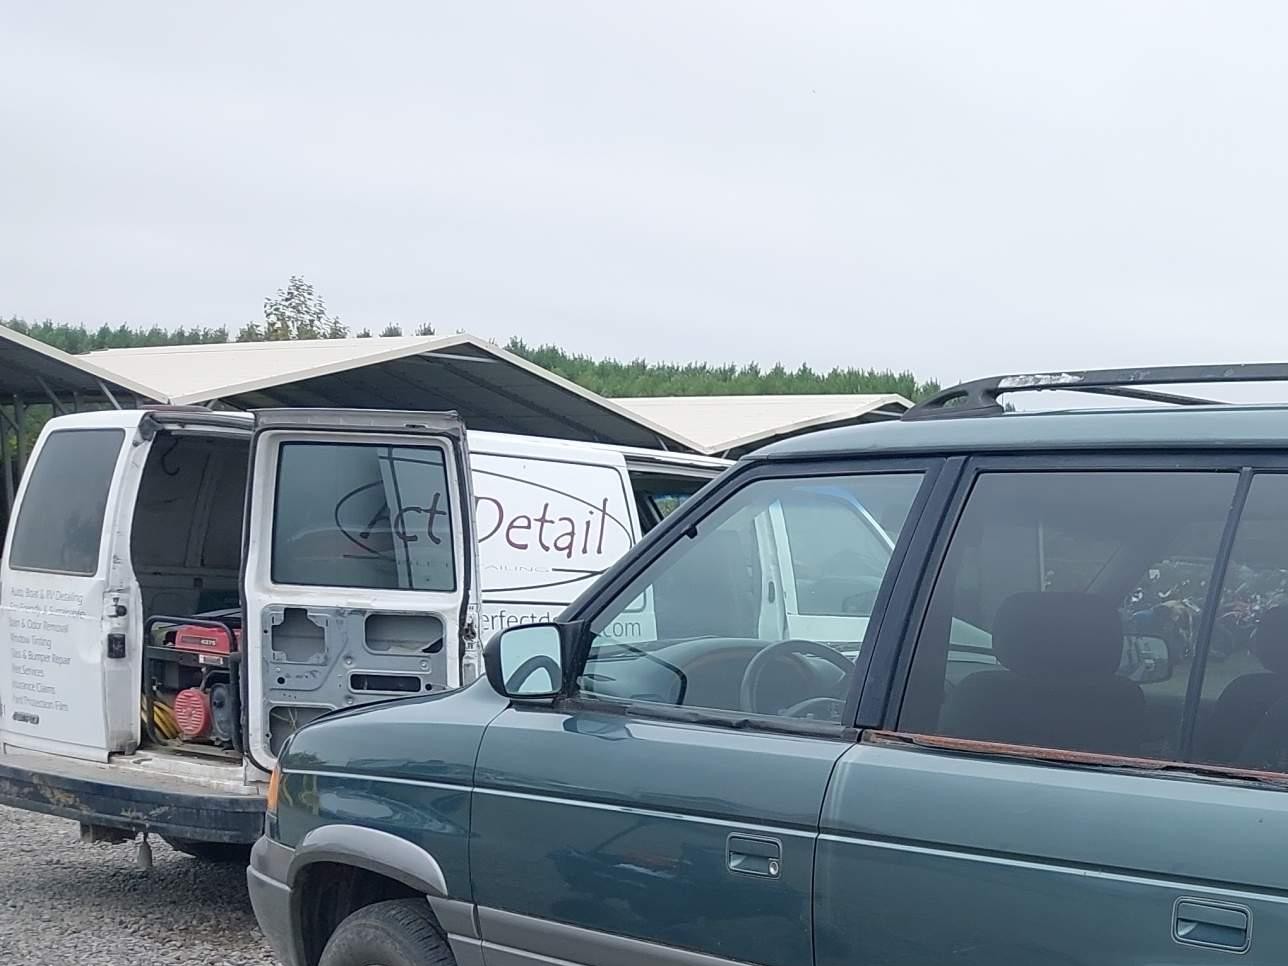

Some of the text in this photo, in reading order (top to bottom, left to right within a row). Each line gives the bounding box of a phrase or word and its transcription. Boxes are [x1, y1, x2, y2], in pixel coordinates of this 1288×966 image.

[474, 498, 608, 559] Detail
[603, 620, 641, 637] com
[28, 650, 50, 664] Bumper
[52, 653, 72, 667] Repair
